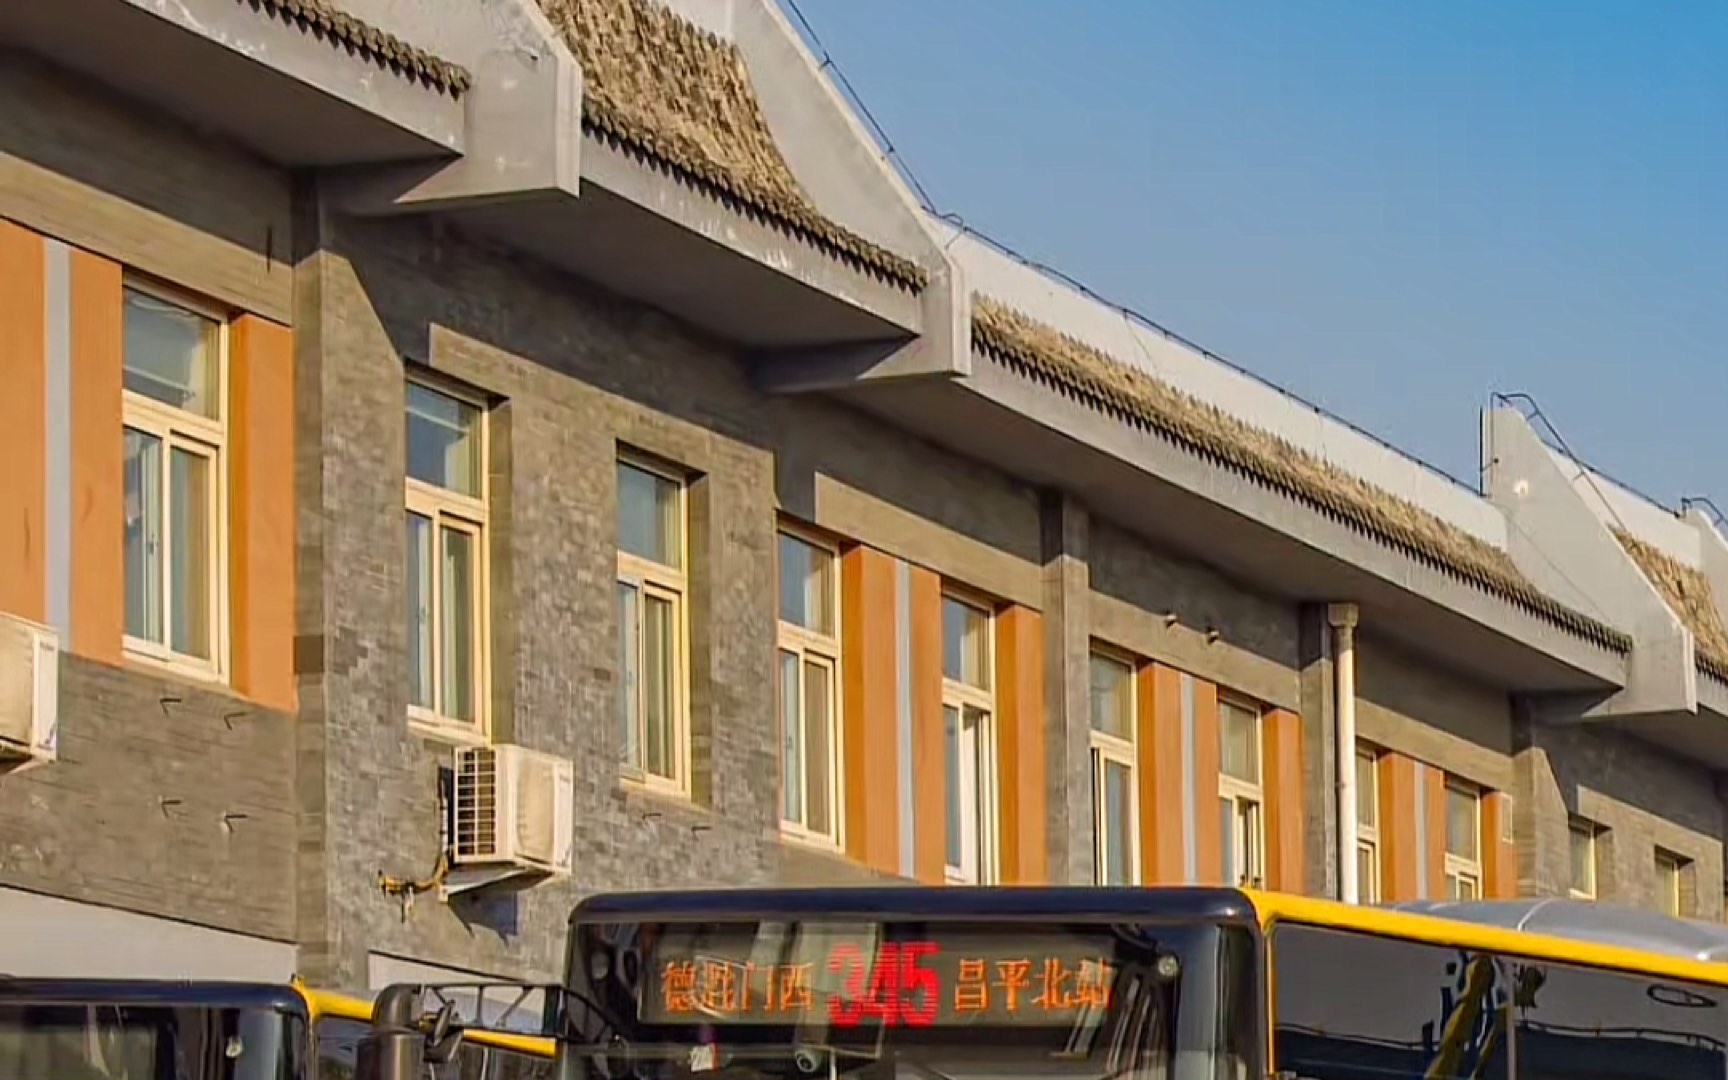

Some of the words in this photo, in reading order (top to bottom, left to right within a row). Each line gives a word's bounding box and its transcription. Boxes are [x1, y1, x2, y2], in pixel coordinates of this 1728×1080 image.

[826, 942, 941, 1028] 345
[954, 956, 1114, 1014] 昌平北站
